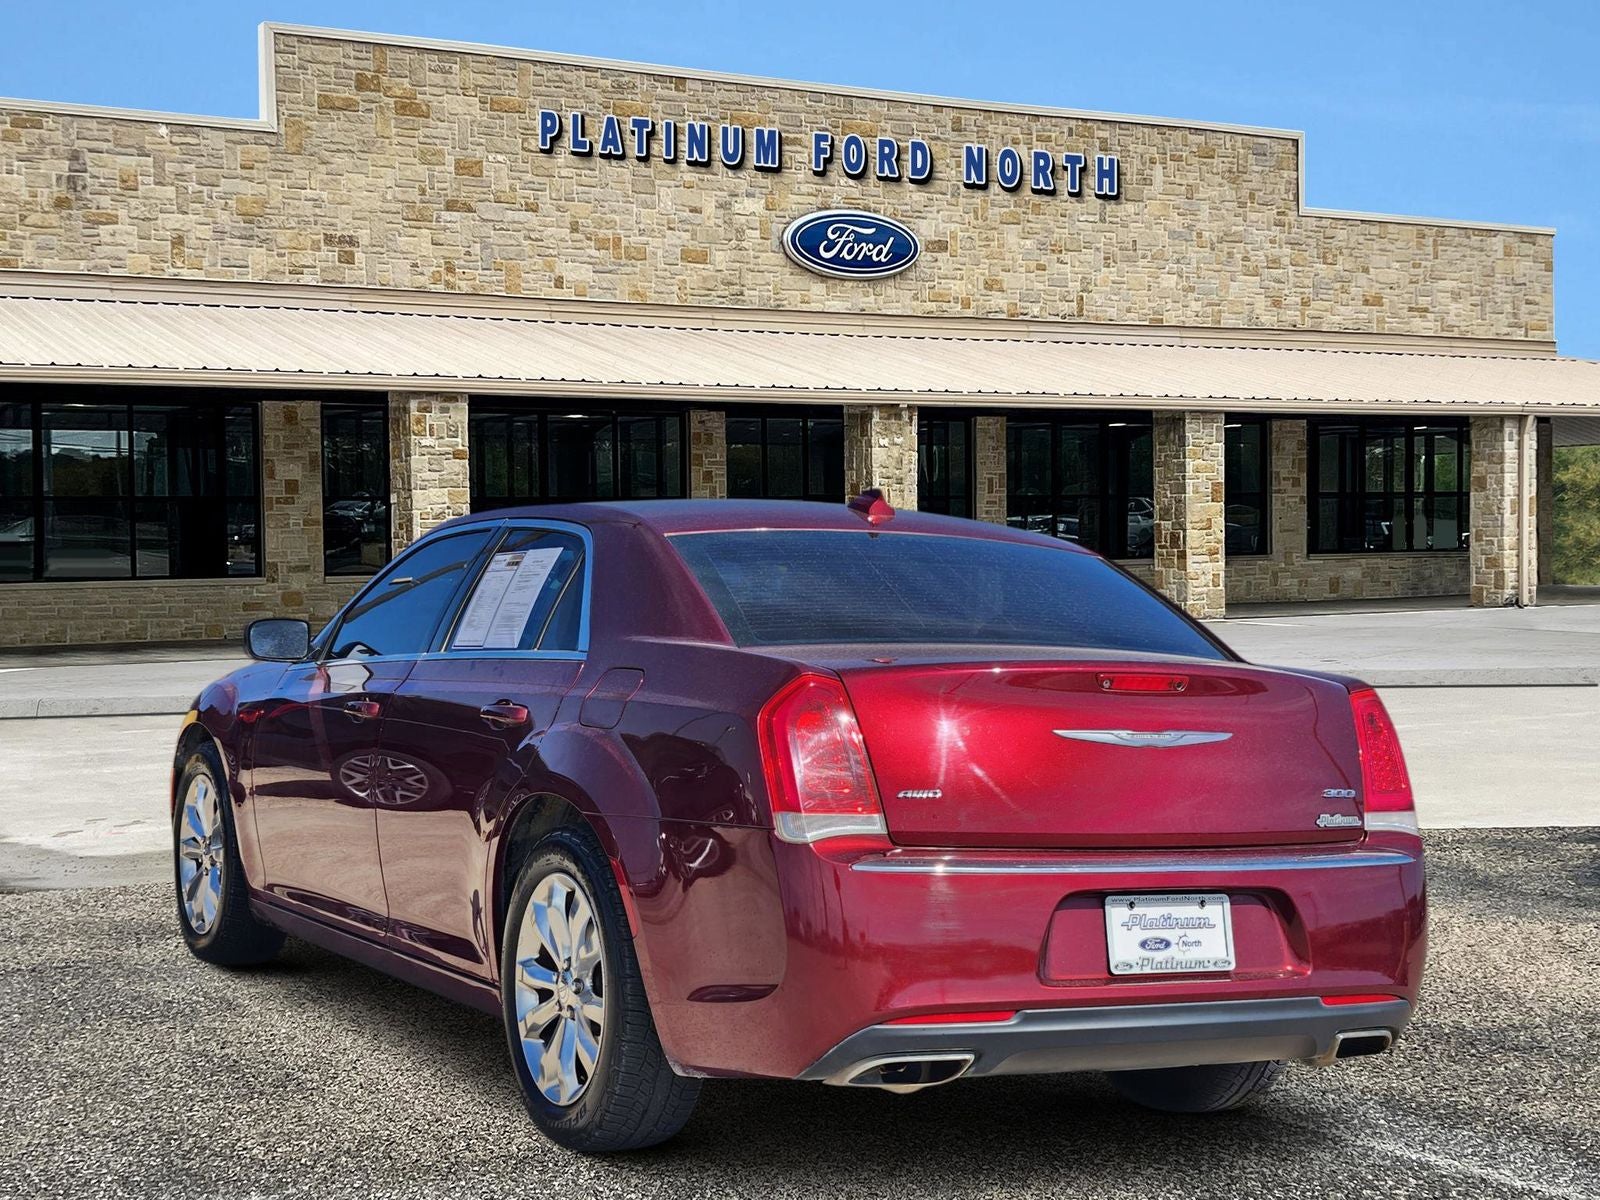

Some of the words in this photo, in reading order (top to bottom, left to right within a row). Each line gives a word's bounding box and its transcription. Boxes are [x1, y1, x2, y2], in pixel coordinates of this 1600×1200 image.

[538, 110, 782, 173] PLATINUM
[812, 132, 934, 184] FORD
[964, 145, 1121, 200] NORTH
[818, 222, 896, 265] Ford
[897, 788, 943, 799] AWD
[1321, 788, 1356, 799] 300
[1315, 813, 1362, 828] Platinum
[1111, 895, 1224, 903] www.PlatinumFordNorth.com
[1121, 913, 1216, 931] Platinum
[1145, 938, 1167, 950] Ford
[1181, 939, 1202, 948] North
[1139, 956, 1211, 972] Platinum
